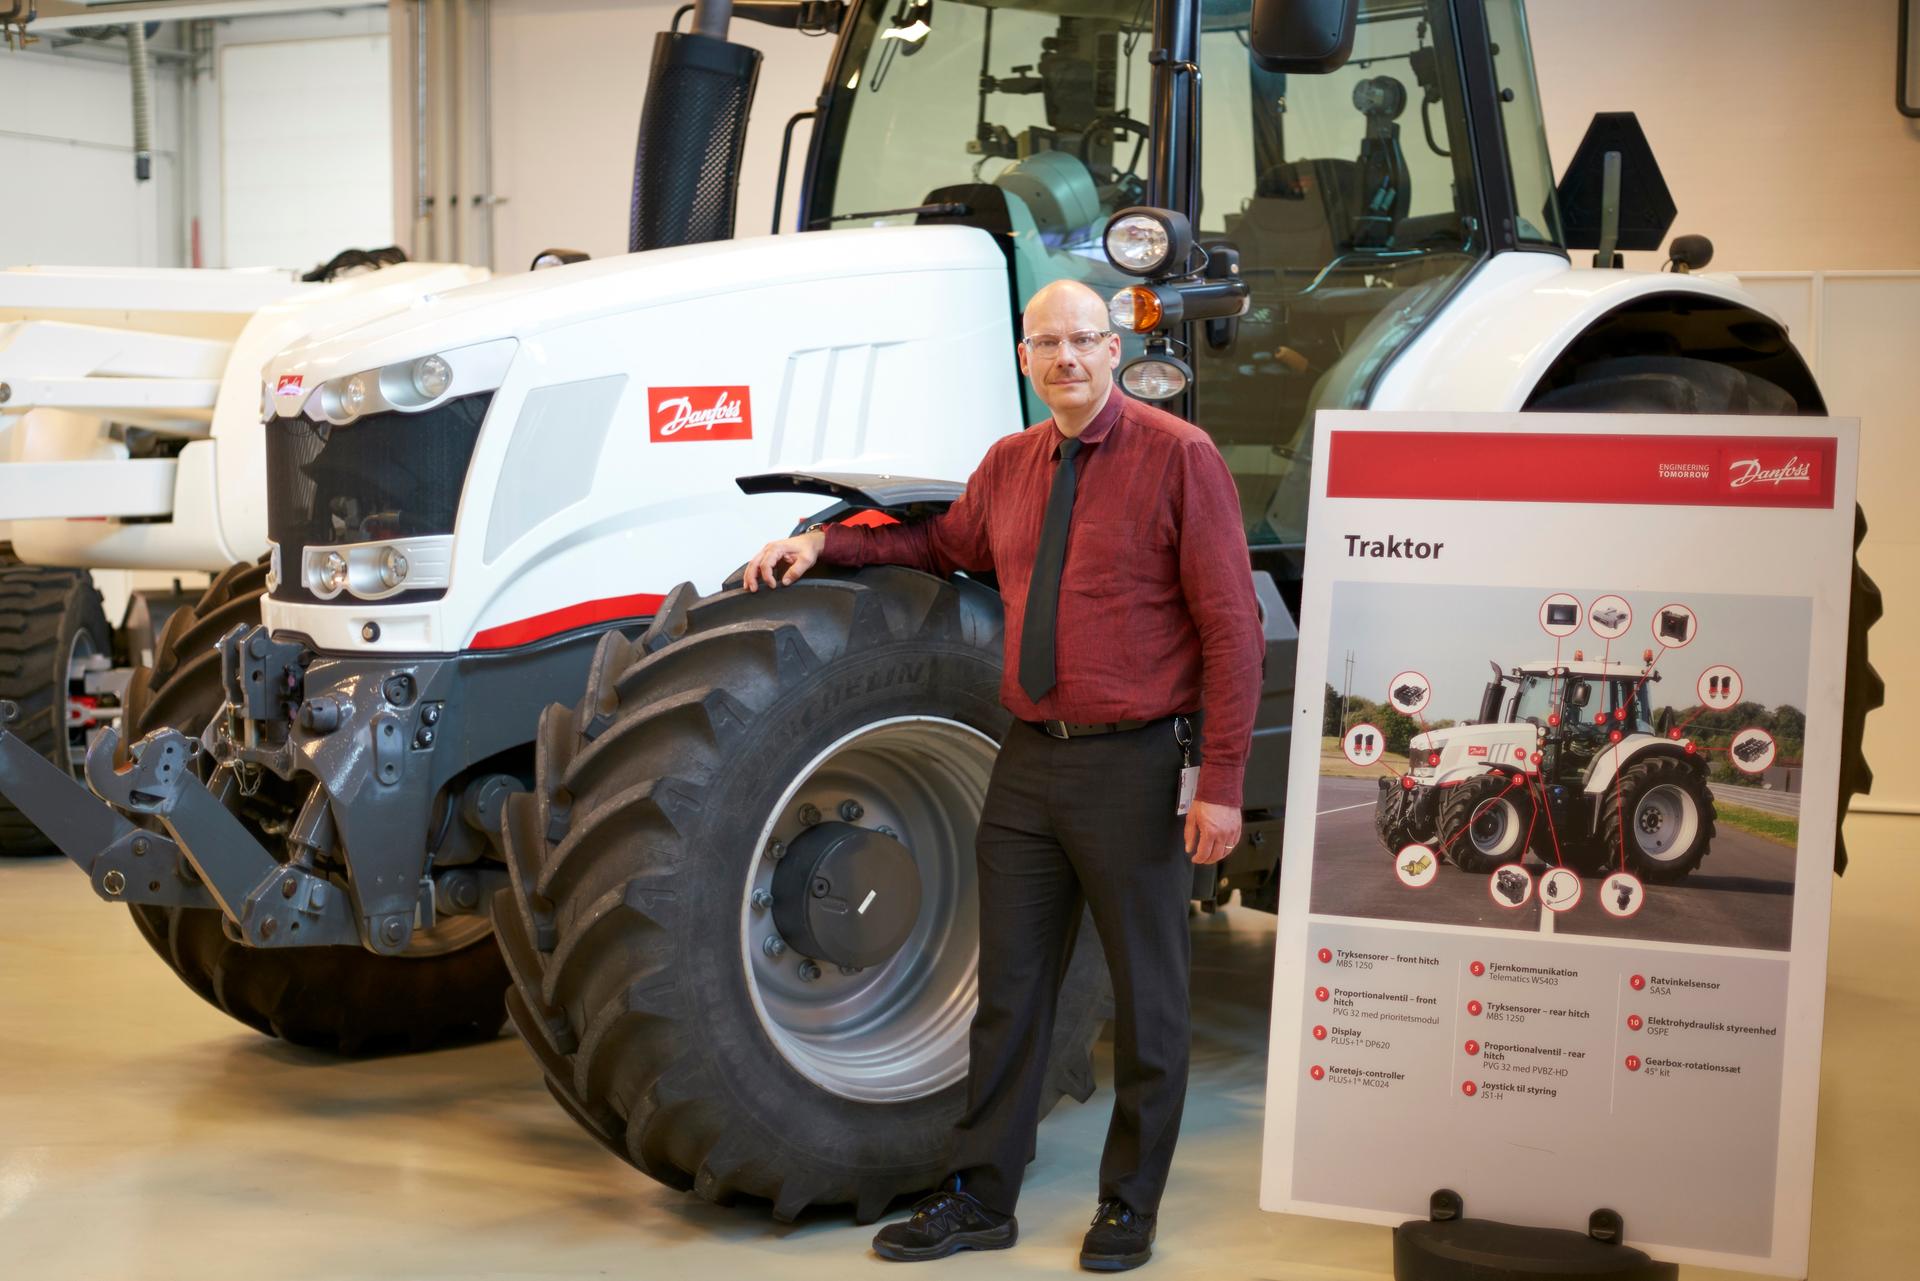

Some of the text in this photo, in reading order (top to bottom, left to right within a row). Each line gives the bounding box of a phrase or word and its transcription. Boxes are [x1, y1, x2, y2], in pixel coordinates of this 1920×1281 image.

[657, 391, 743, 436] Danfoss
[1659, 463, 1710, 471] ENGINEERING
[1729, 456, 1810, 488] Danfoss
[1659, 471, 1709, 479] TOMORROW
[1344, 534, 1444, 559] Traktor
[1337, 949, 1389, 961] Tryksensorer
[1397, 955, 1417, 964] front
[1418, 956, 1440, 966] hitch
[1336, 960, 1373, 970] MBS 1250
[1489, 963, 1578, 977] Fjernkommunikation
[1489, 973, 1558, 986] Telematics WS403
[1650, 976, 1720, 990] Ratvinkelsensor
[1334, 988, 1408, 1002] Proportionalventil
[1416, 995, 1437, 1005] front
[1650, 986, 1672, 995] SASA
[1333, 998, 1354, 1007] hitch
[1333, 1007, 1440, 1025] PVG 32 med prioritetsmodul
[1487, 1002, 1541, 1014] Tryksensorer
[1549, 1009, 1566, 1017] rear
[1568, 1009, 1590, 1018] hitch
[1486, 1012, 1525, 1023] MBS 1250
[1331, 1027, 1361, 1038] Display
[1647, 1027, 1669, 1036] OSPE
[1648, 1017, 1724, 1031] Elektrohydraulisk
[1726, 1024, 1777, 1036] styreenhed
[1365, 1040, 1390, 1049] DP620
[1484, 1041, 1561, 1056] Proportionalventil
[1568, 1050, 1586, 1058] rear
[1483, 1051, 1505, 1060] hitch
[1483, 1061, 1568, 1077] PVG 32 med PVBZ-HD
[1645, 1057, 1741, 1073] Gearbox-rotationssæt
[1329, 1065, 1405, 1080] Køretøjs-controller
[1659, 1068, 1670, 1077] kit
[1362, 1079, 1390, 1088] MC024
[1481, 1081, 1515, 1092] Joystick
[1527, 1086, 1557, 1097] styring
[1481, 1091, 1503, 1100] JS1-H
